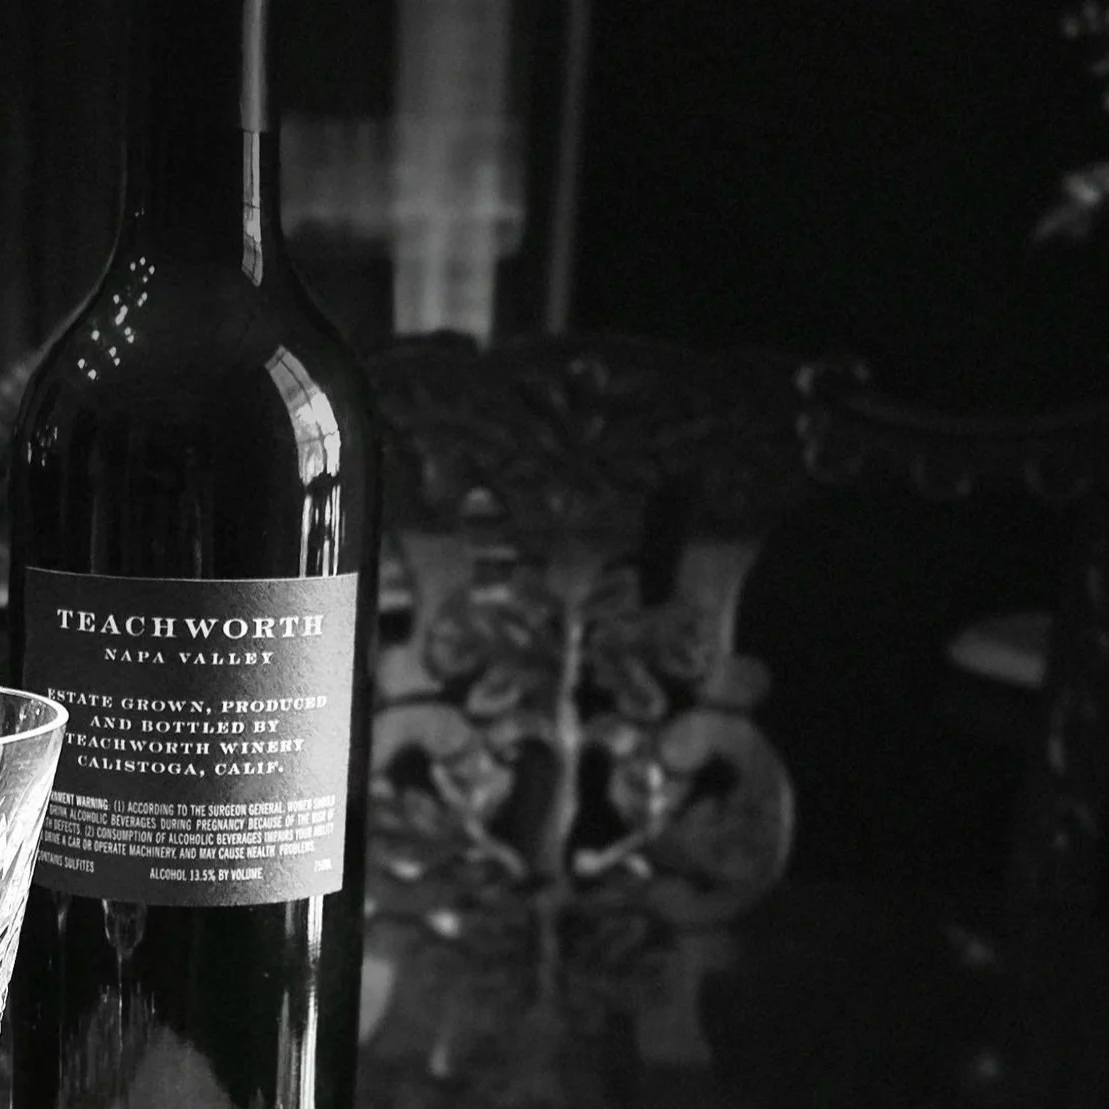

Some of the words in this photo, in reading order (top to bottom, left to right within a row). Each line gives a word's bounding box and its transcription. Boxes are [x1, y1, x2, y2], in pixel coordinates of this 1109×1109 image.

[57, 609, 324, 639] TEACHWORTH
[104, 648, 165, 664] NAPA
[179, 652, 274, 666] VALLEY
[47, 688, 113, 708] ESTATE
[121, 698, 212, 715] GROWN,
[221, 696, 328, 713] PRODUCED
[90, 716, 132, 730] AND
[141, 720, 244, 734] BOTTLED
[254, 719, 280, 733] BY
[66, 732, 210, 755] TEACHWORTH
[219, 739, 305, 755] WINERY
[77, 755, 206, 777] CALISTOGA,
[215, 760, 284, 776] CALIF.
[114, 800, 125, 813] (1)
[127, 800, 174, 815] ACCORDING
[178, 804, 188, 816] TO
[191, 804, 206, 817] THE
[208, 803, 247, 817] SURGEON
[69, 808, 108, 826] ALCOHOLIC
[111, 813, 157, 829] BEVERAGES
[160, 818, 192, 831] DURING
[196, 818, 244, 831] PREGNANCY
[248, 816, 282, 831] BECAUSE
[285, 814, 294, 827] OF
[297, 813, 310, 826] THE
[85, 824, 95, 837] (2)
[97, 826, 153, 843] CONSUMPTION
[156, 832, 166, 844] OF
[168, 832, 214, 845] ALCOHOLIC
[217, 831, 261, 845] BEVERAGES
[264, 829, 294, 844] IMPAIRS
[62, 835, 67, 847] A
[67, 836, 81, 850] CAR
[82, 838, 92, 852] OR
[94, 841, 126, 856] OPERATE
[179, 847, 197, 860] AND
[199, 847, 216, 860] MAY
[218, 846, 245, 860] CAUSE
[246, 845, 276, 858] HEALTH
[64, 856, 95, 874] SULFITES
[149, 867, 188, 881] ALCOHOL
[190, 868, 216, 882] 13.5%
[218, 868, 229, 881] BY
[231, 867, 264, 881] VOLUME
